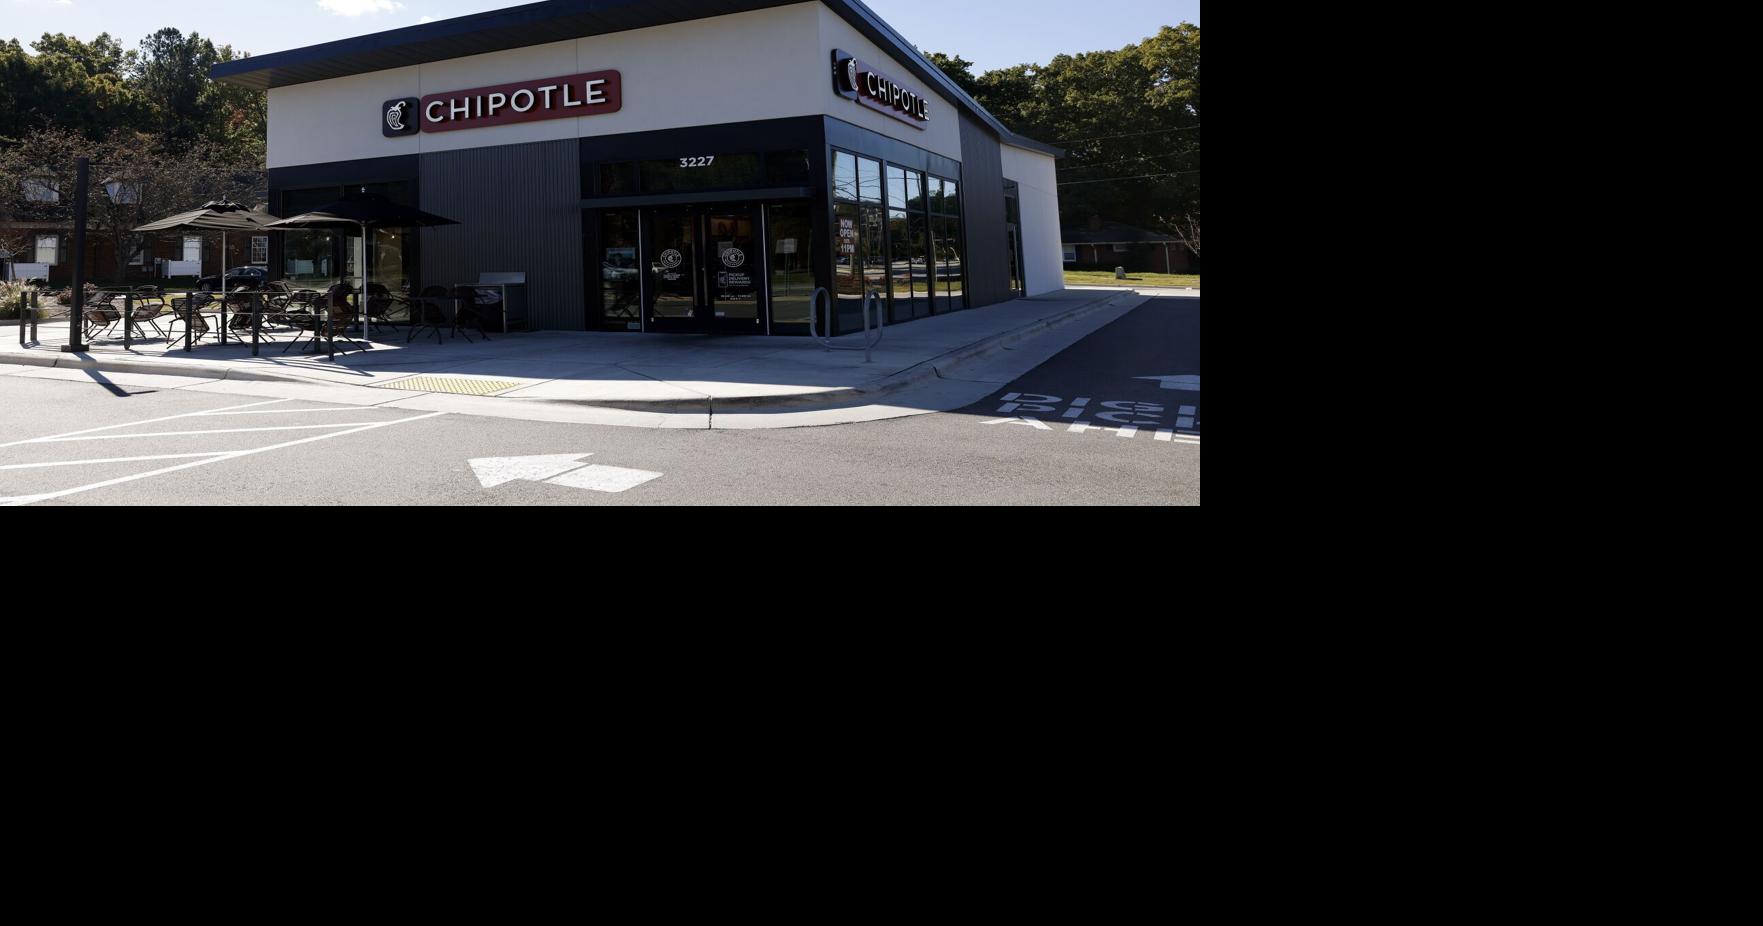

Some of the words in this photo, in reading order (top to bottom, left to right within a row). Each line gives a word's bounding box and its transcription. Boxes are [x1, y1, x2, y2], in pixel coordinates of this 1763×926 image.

[425, 79, 606, 123] CHIPOTLE
[867, 71, 930, 121] CHIPOTLE
[680, 155, 715, 168] 3227
[840, 218, 853, 229] NOW
[840, 228, 854, 238] OPEN
[840, 243, 855, 253] 11PM
